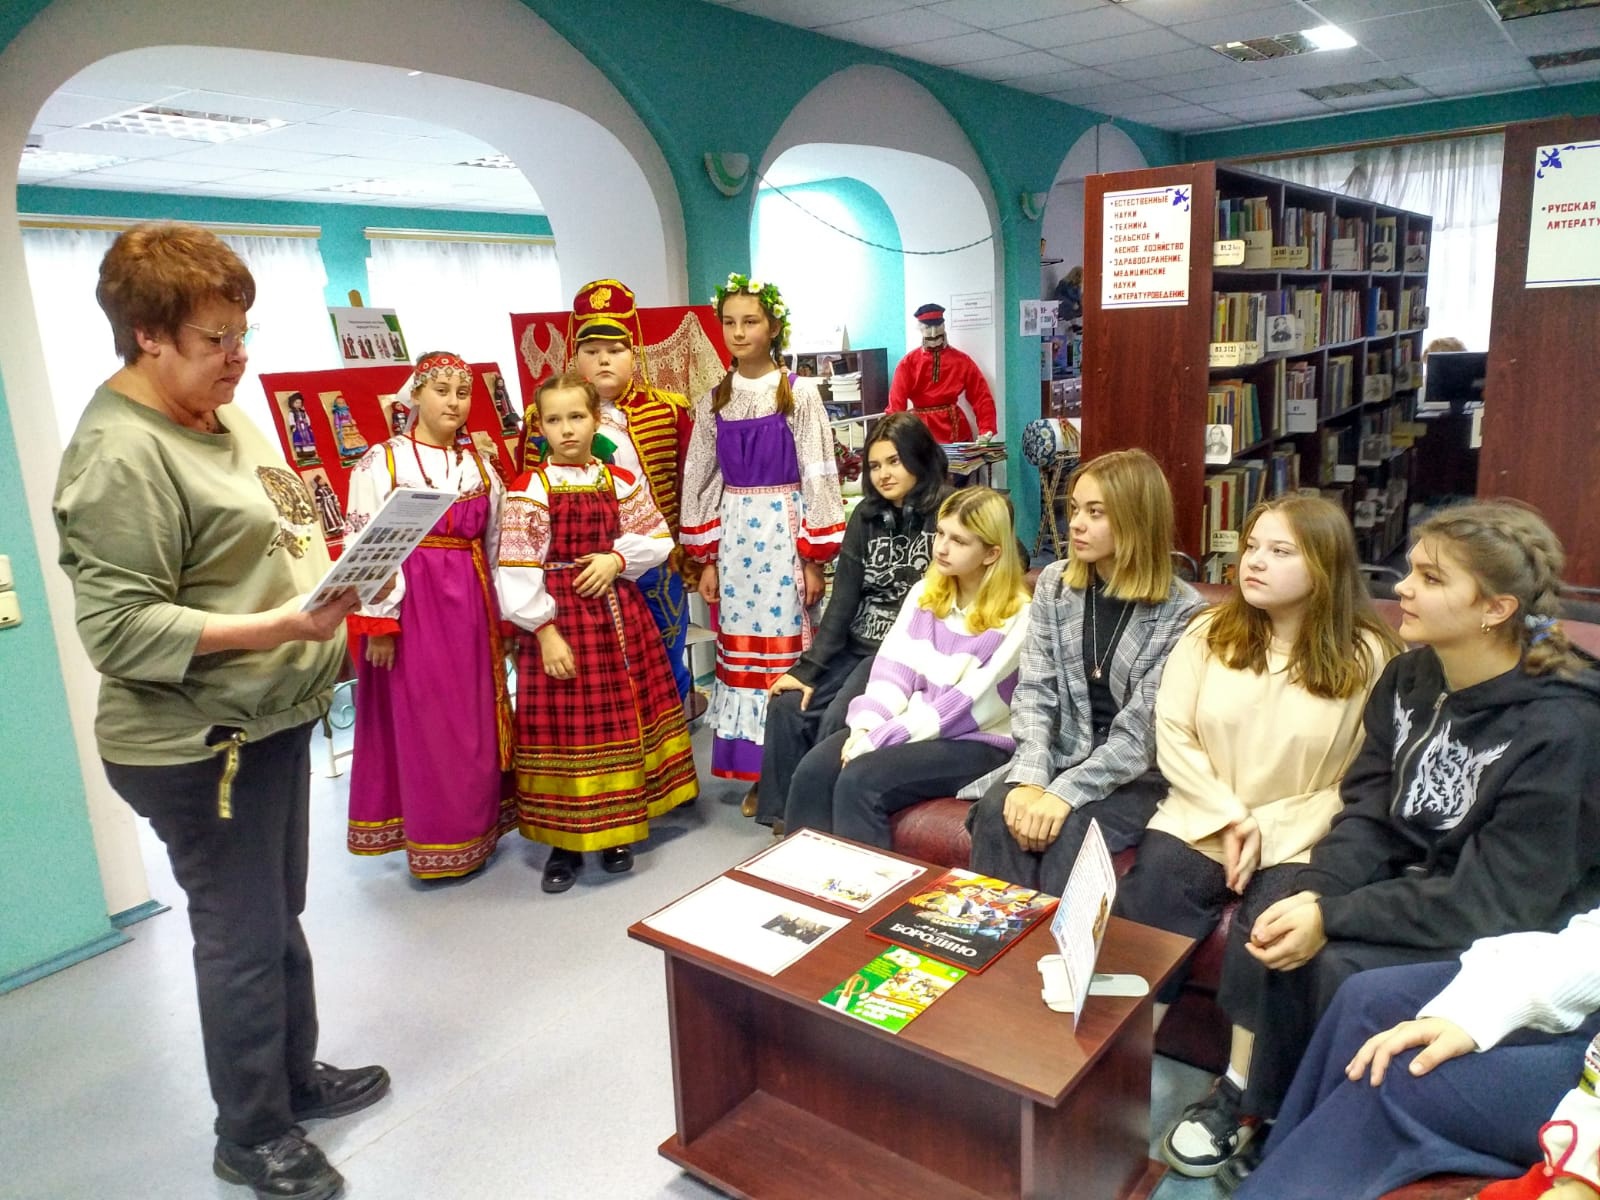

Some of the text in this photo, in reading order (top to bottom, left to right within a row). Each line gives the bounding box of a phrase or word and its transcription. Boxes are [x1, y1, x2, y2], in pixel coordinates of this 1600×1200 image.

[1114, 195, 1169, 207] ЕСТЕСТВЕННЫЕ
[1548, 201, 1596, 213] РУССКАЯ
[1114, 210, 1137, 219] НАУКИ
[1114, 221, 1147, 231] ТЕХНИКА
[1114, 233, 1150, 243] СЕЛЬСКОЕ
[1114, 245, 1139, 254] ЛЕСНОЕ
[1113, 267, 1166, 277] МЕДИЦИНСКИЕ
[1113, 281, 1136, 289] НАУКИ
[1113, 290, 1185, 301] ЛИТЕРАТУРОВЕДЕНИЕ
[890, 923, 977, 957] БОРОДИНО
